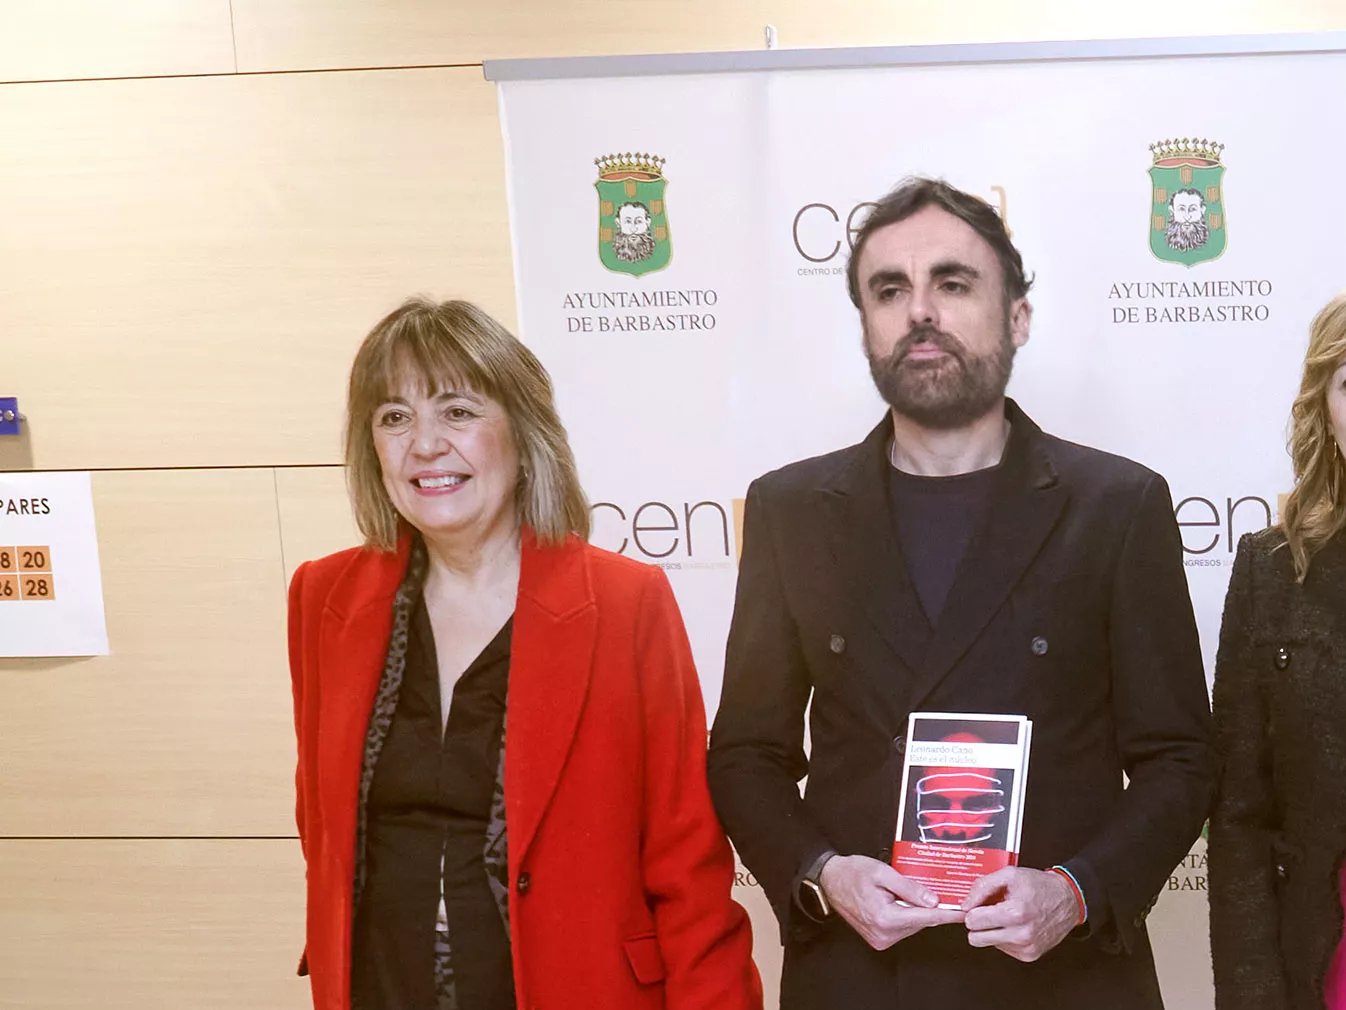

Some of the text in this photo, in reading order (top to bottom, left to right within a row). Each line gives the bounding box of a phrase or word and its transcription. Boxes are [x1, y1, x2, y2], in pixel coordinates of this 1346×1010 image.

[797, 268, 831, 276] CENTRO
[1108, 280, 1273, 299] AYUNTAMIENTO
[563, 289, 718, 309] AYUNTAMIENTO
[568, 313, 716, 332] DE BARBASTRO
[1112, 305, 1270, 323] DE BARBASTRO
[23, 551, 45, 568] 20
[26, 579, 48, 596] 28
